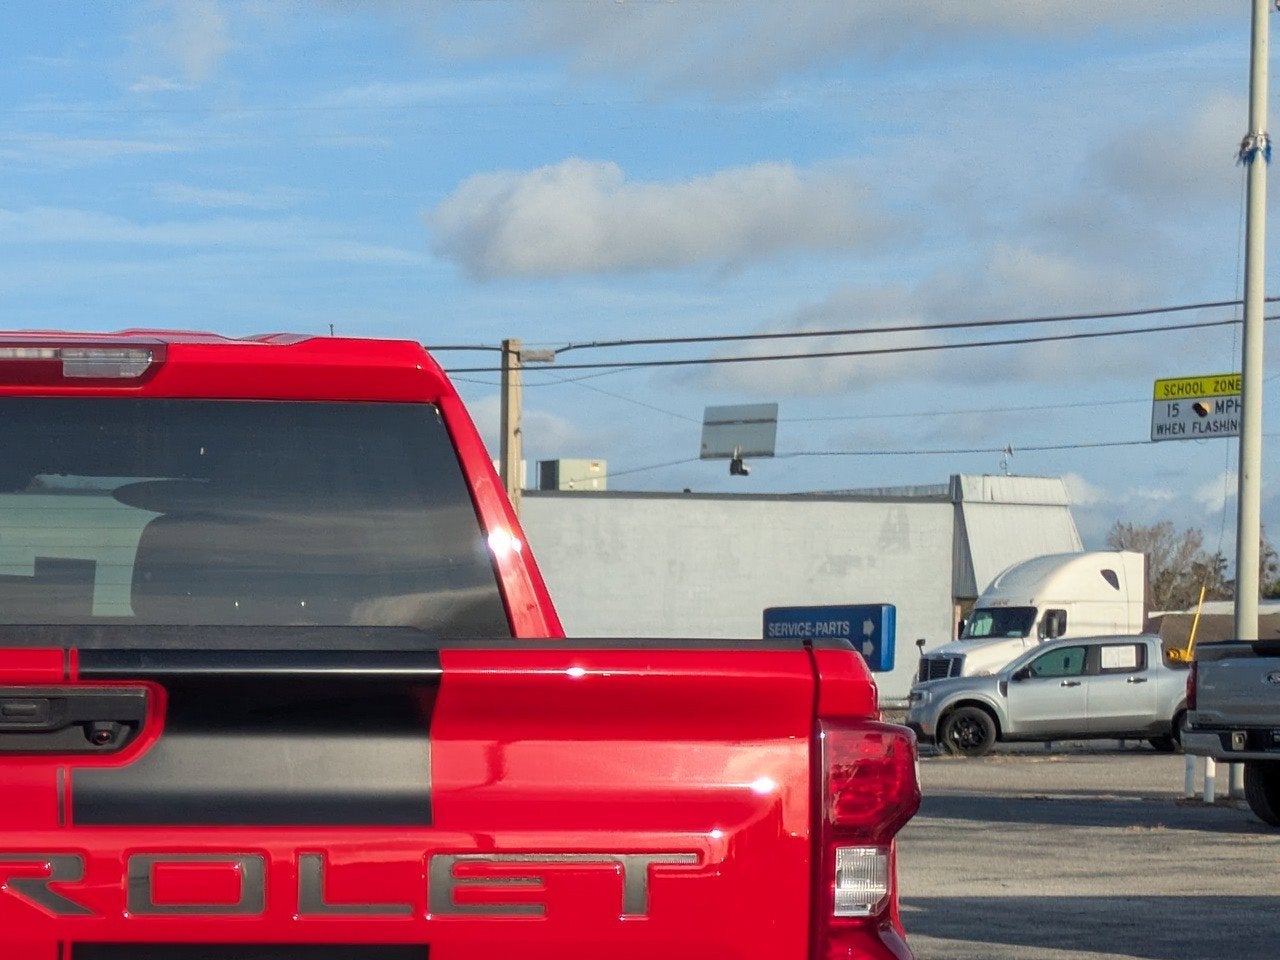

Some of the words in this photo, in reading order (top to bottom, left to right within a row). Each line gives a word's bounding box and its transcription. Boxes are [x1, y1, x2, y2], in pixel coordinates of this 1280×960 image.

[1164, 382, 1206, 397] SCHOOL
[1213, 379, 1242, 393] ZONE
[1167, 403, 1179, 418] 15
[1215, 398, 1242, 415] MPH
[1156, 421, 1186, 435] WHEN
[1192, 419, 1241, 434] FLASHIN
[768, 620, 850, 637] SERVICE-PARTS
